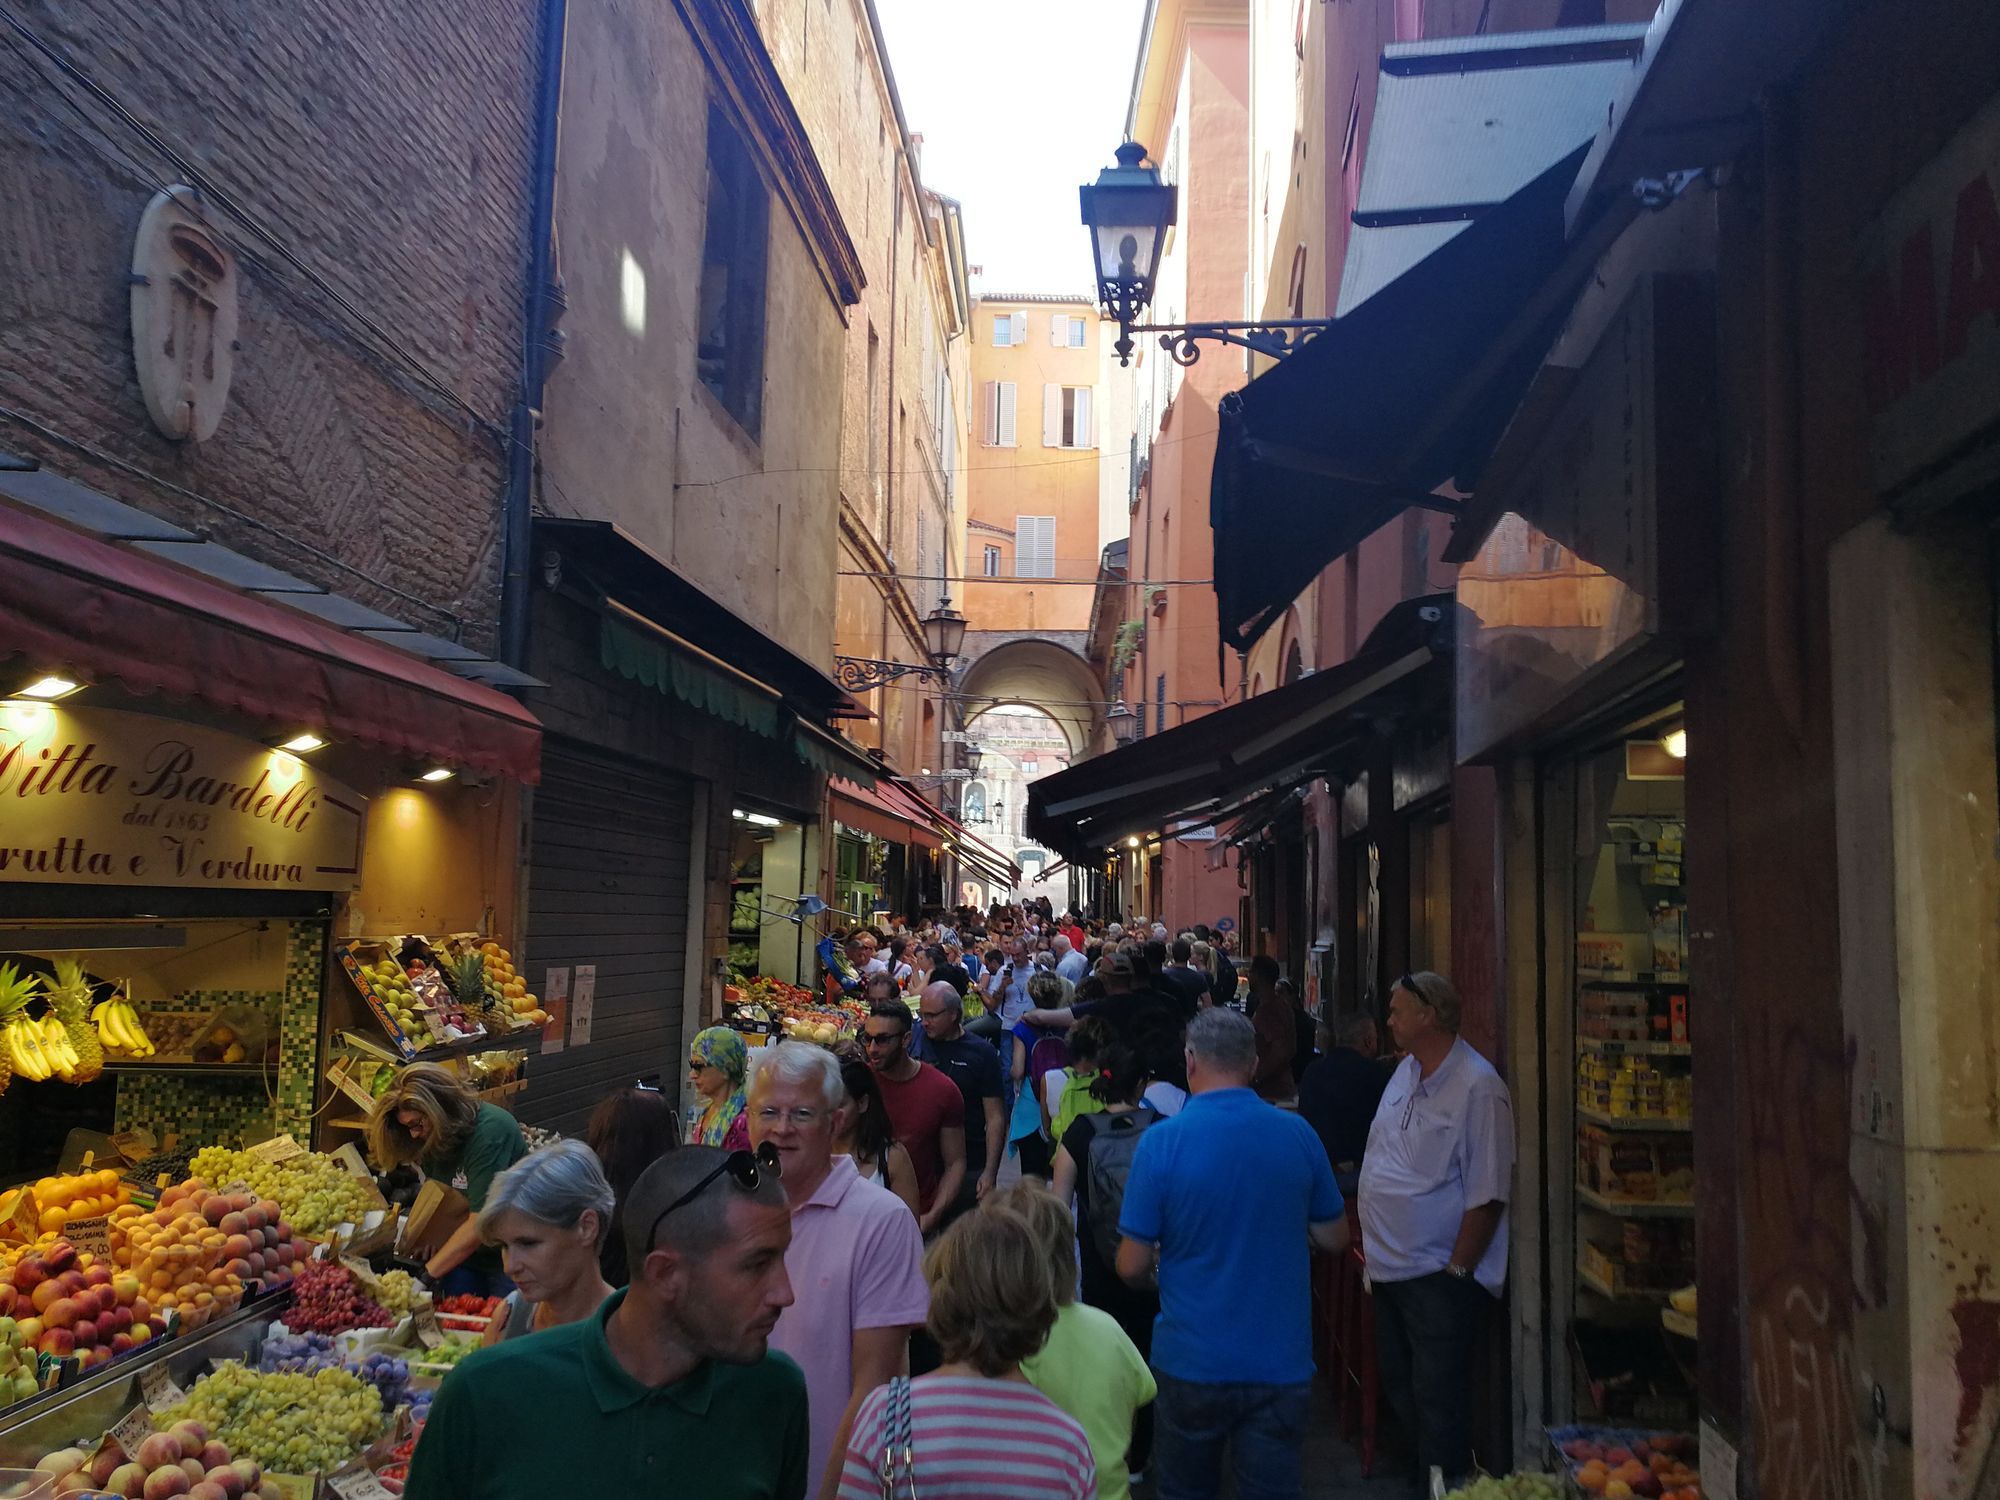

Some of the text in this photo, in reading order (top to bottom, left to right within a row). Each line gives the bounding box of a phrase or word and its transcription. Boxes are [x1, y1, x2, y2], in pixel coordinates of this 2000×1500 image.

[128, 740, 317, 832] Bardelli
[122, 803, 159, 829] dal
[0, 835, 302, 883] rutta e Verdura
